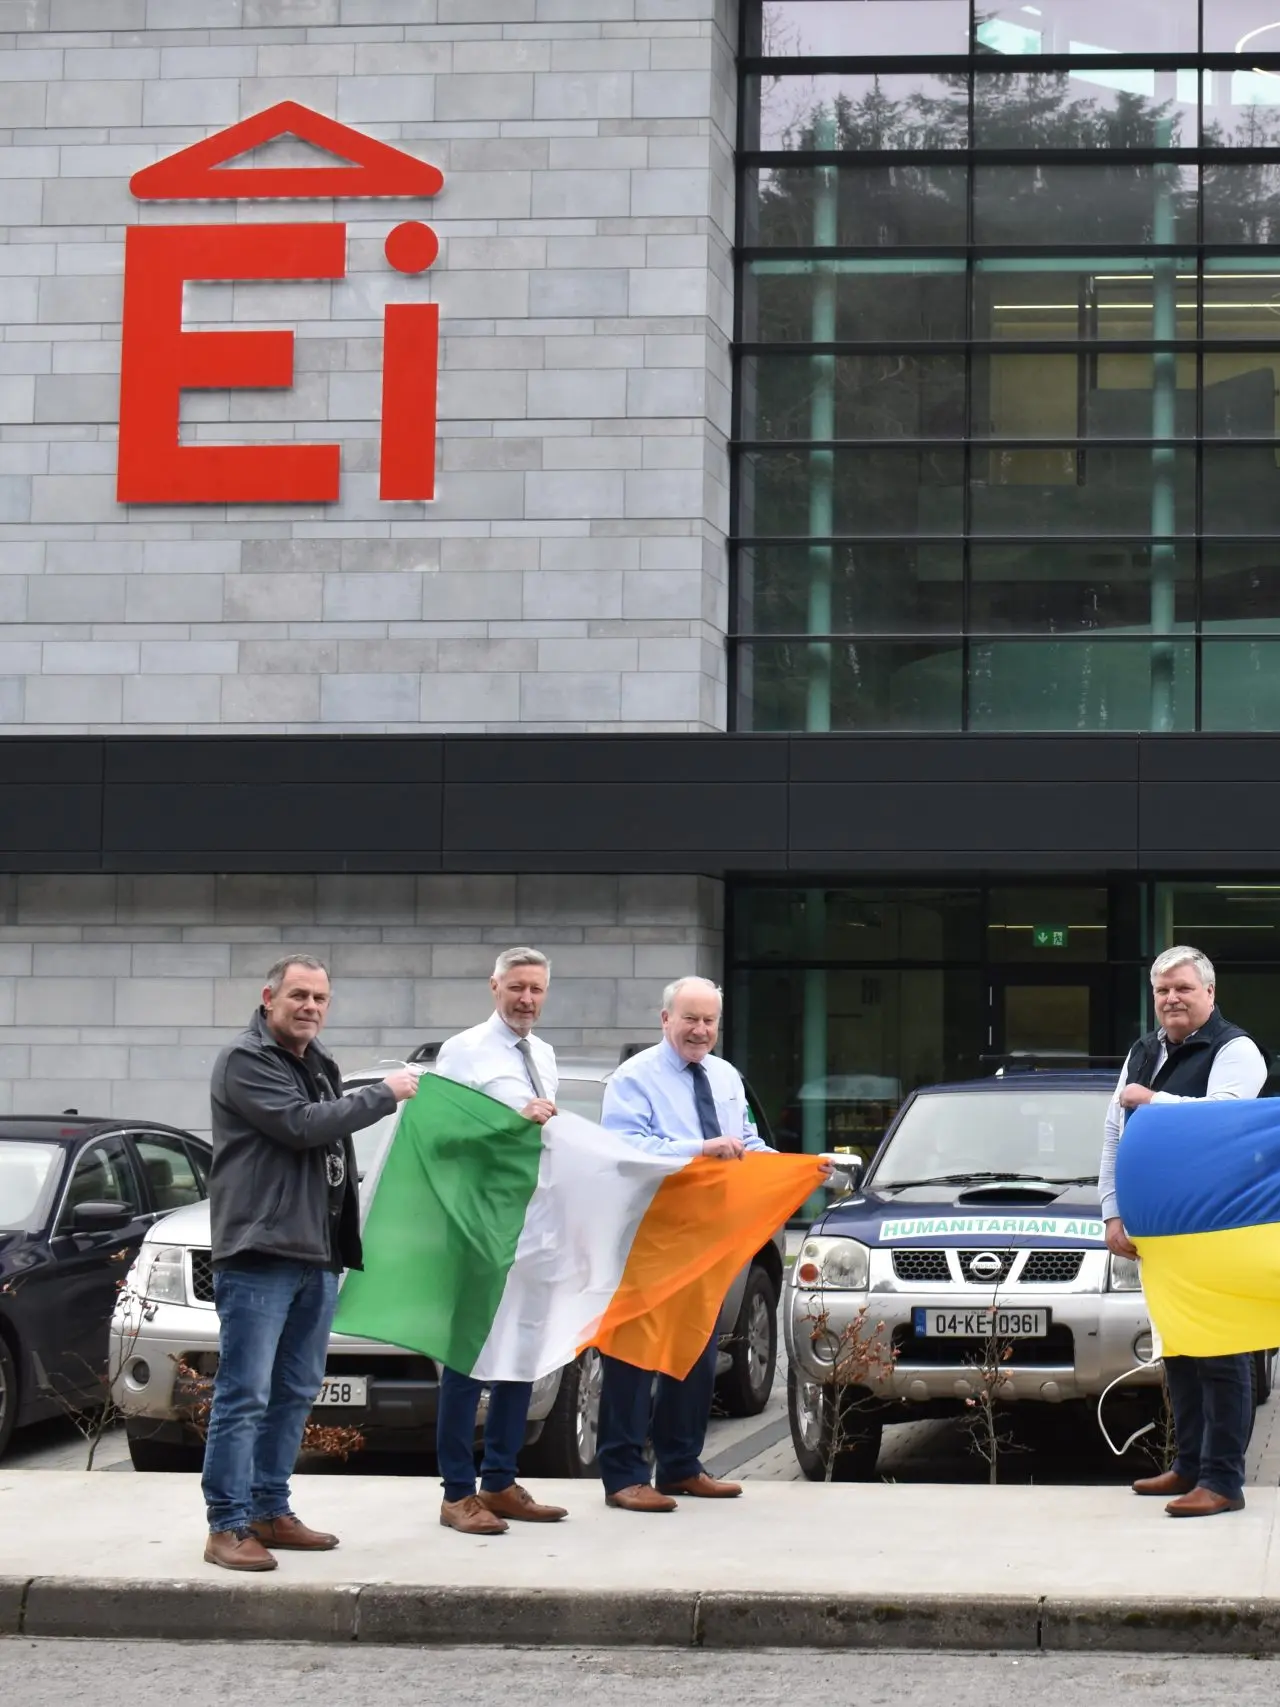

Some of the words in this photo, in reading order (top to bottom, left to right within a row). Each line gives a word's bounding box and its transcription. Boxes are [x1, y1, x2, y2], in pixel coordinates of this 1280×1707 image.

[117, 220, 439, 503] Ei
[883, 1219, 1056, 1237] HUMANITARIAN
[1064, 1221, 1103, 1236] AID
